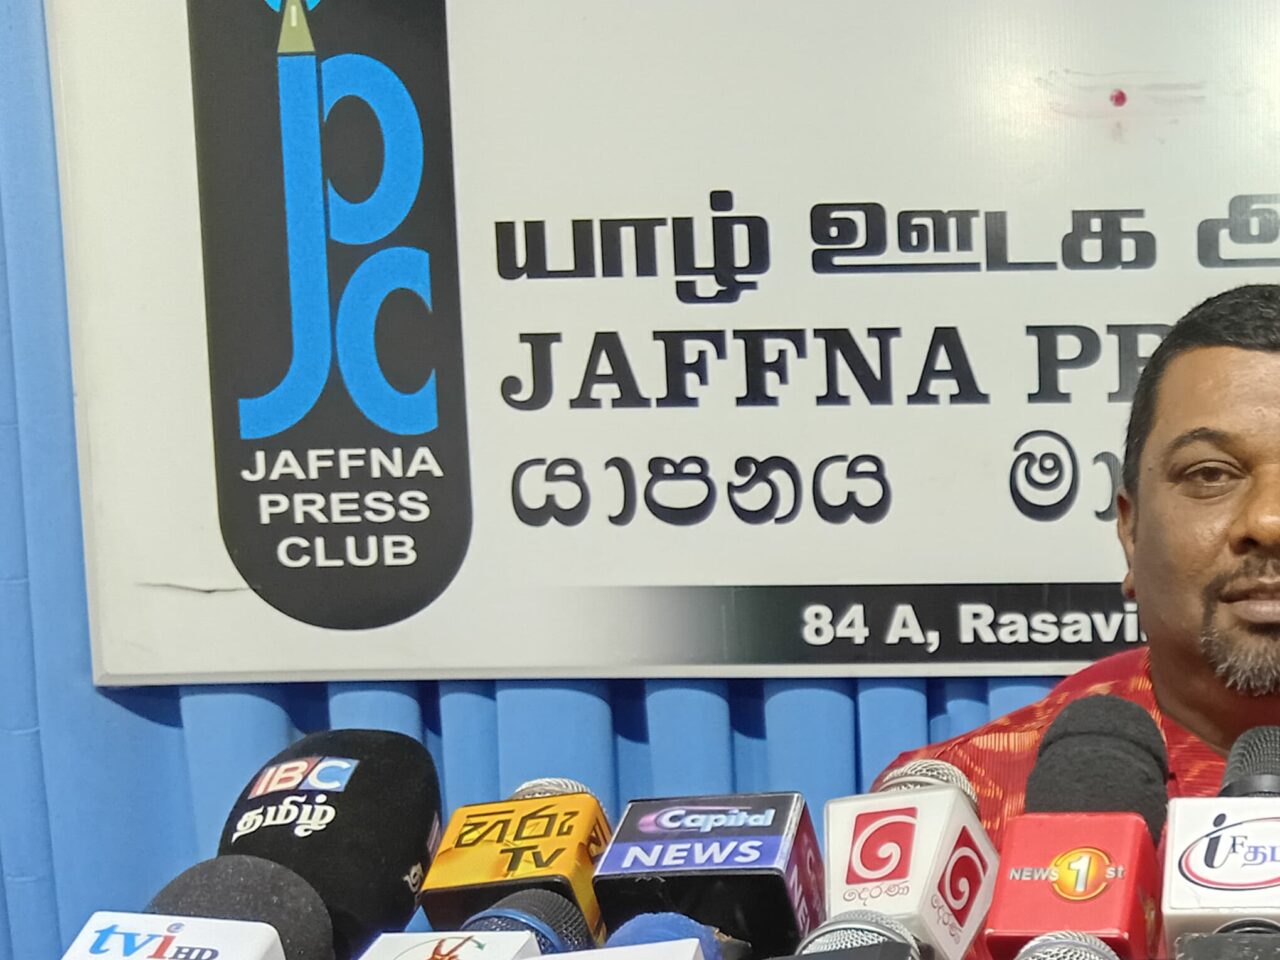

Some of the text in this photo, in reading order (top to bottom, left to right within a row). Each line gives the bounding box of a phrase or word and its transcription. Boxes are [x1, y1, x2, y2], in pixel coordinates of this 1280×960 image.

[494, 189, 771, 304] யாழ்
[810, 201, 1157, 275] ஊடக
[500, 326, 990, 411] JAFFNA
[240, 446, 445, 482] JAFFNA
[259, 490, 432, 525] PRESS
[510, 453, 892, 527] යාපනය
[276, 534, 418, 568] CLUB
[802, 603, 869, 645] 84
[885, 603, 940, 653] A,
[254, 758, 352, 797] IBC
[232, 794, 337, 843] தமிழ்
[657, 807, 777, 832] Capital
[499, 845, 565, 872] TV
[621, 839, 764, 870] NEWS
[1009, 867, 1060, 881] NEWS
